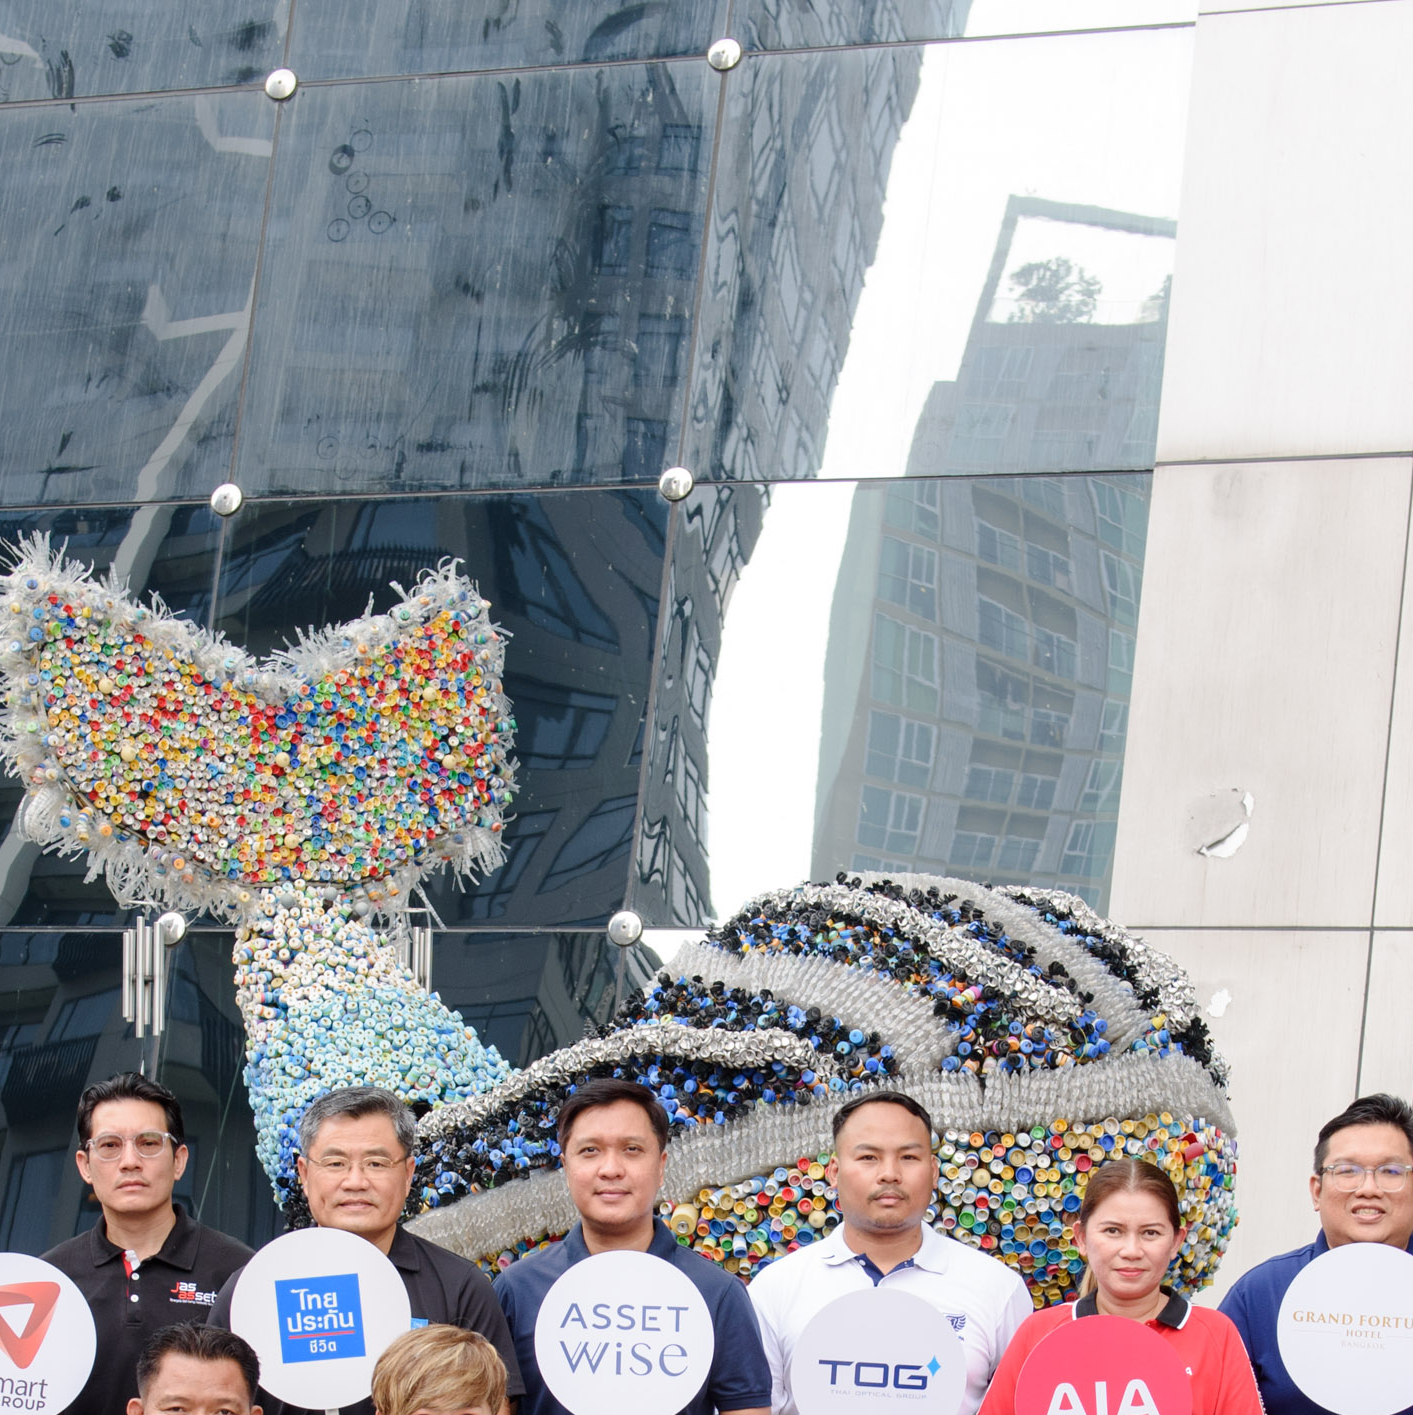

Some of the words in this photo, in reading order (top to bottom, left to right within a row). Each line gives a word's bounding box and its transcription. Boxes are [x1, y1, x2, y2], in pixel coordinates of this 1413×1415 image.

[290, 1288, 338, 1311] ไทย
[286, 1309, 355, 1333] ประกัน
[559, 1302, 690, 1333] ASSET
[1292, 1310, 1354, 1326] GRAND
[1346, 1329, 1383, 1339] HOTEL
[309, 1339, 338, 1353] ชีวิต
[818, 1359, 929, 1390] TOG
